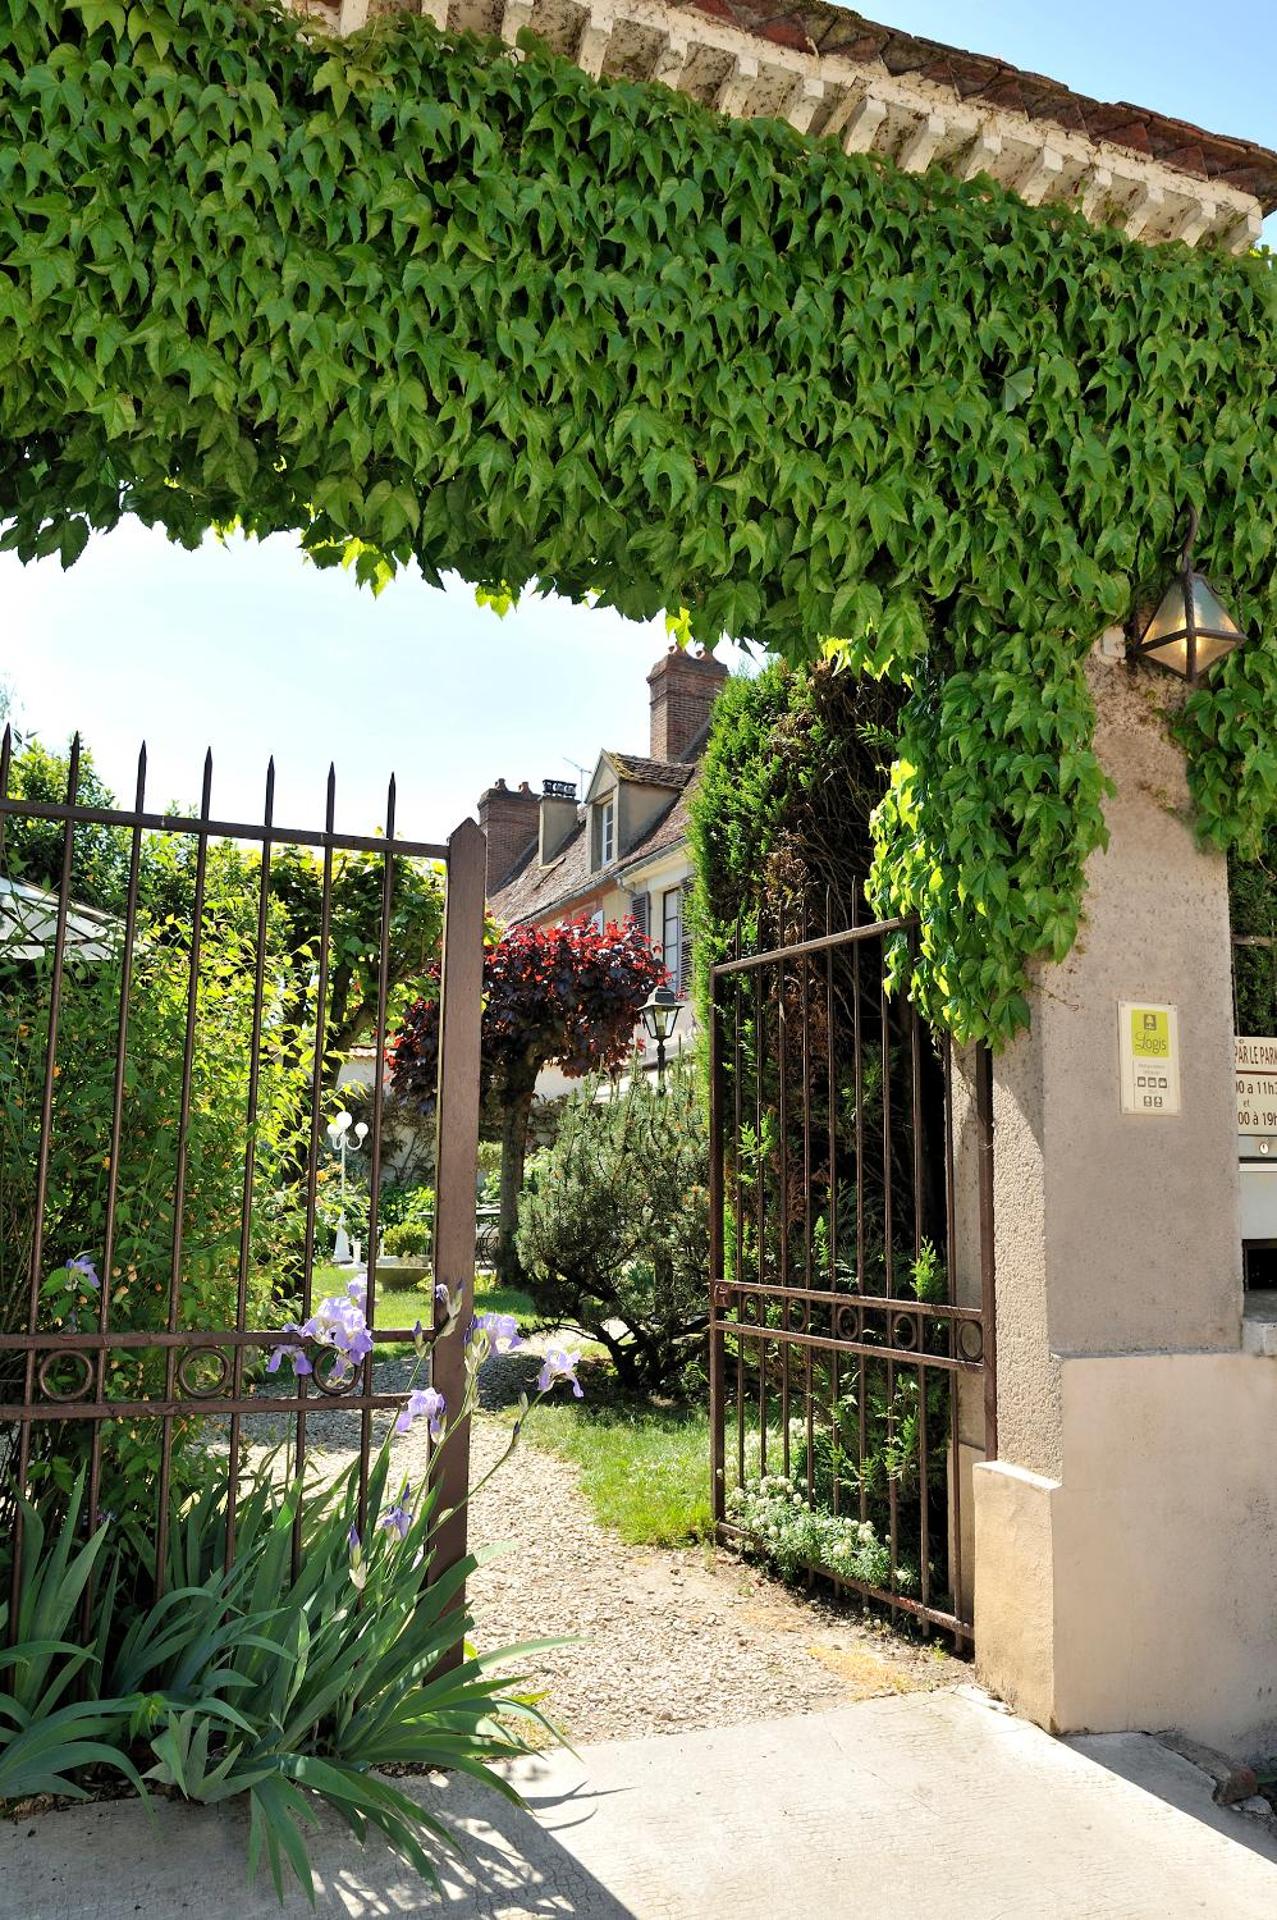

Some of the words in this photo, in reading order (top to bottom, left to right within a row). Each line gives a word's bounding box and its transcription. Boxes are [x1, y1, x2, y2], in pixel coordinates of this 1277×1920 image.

[1135, 1030, 1167, 1054] Logis
[1249, 1046, 1259, 1065] LE
[1252, 1111, 1259, 1126] à
